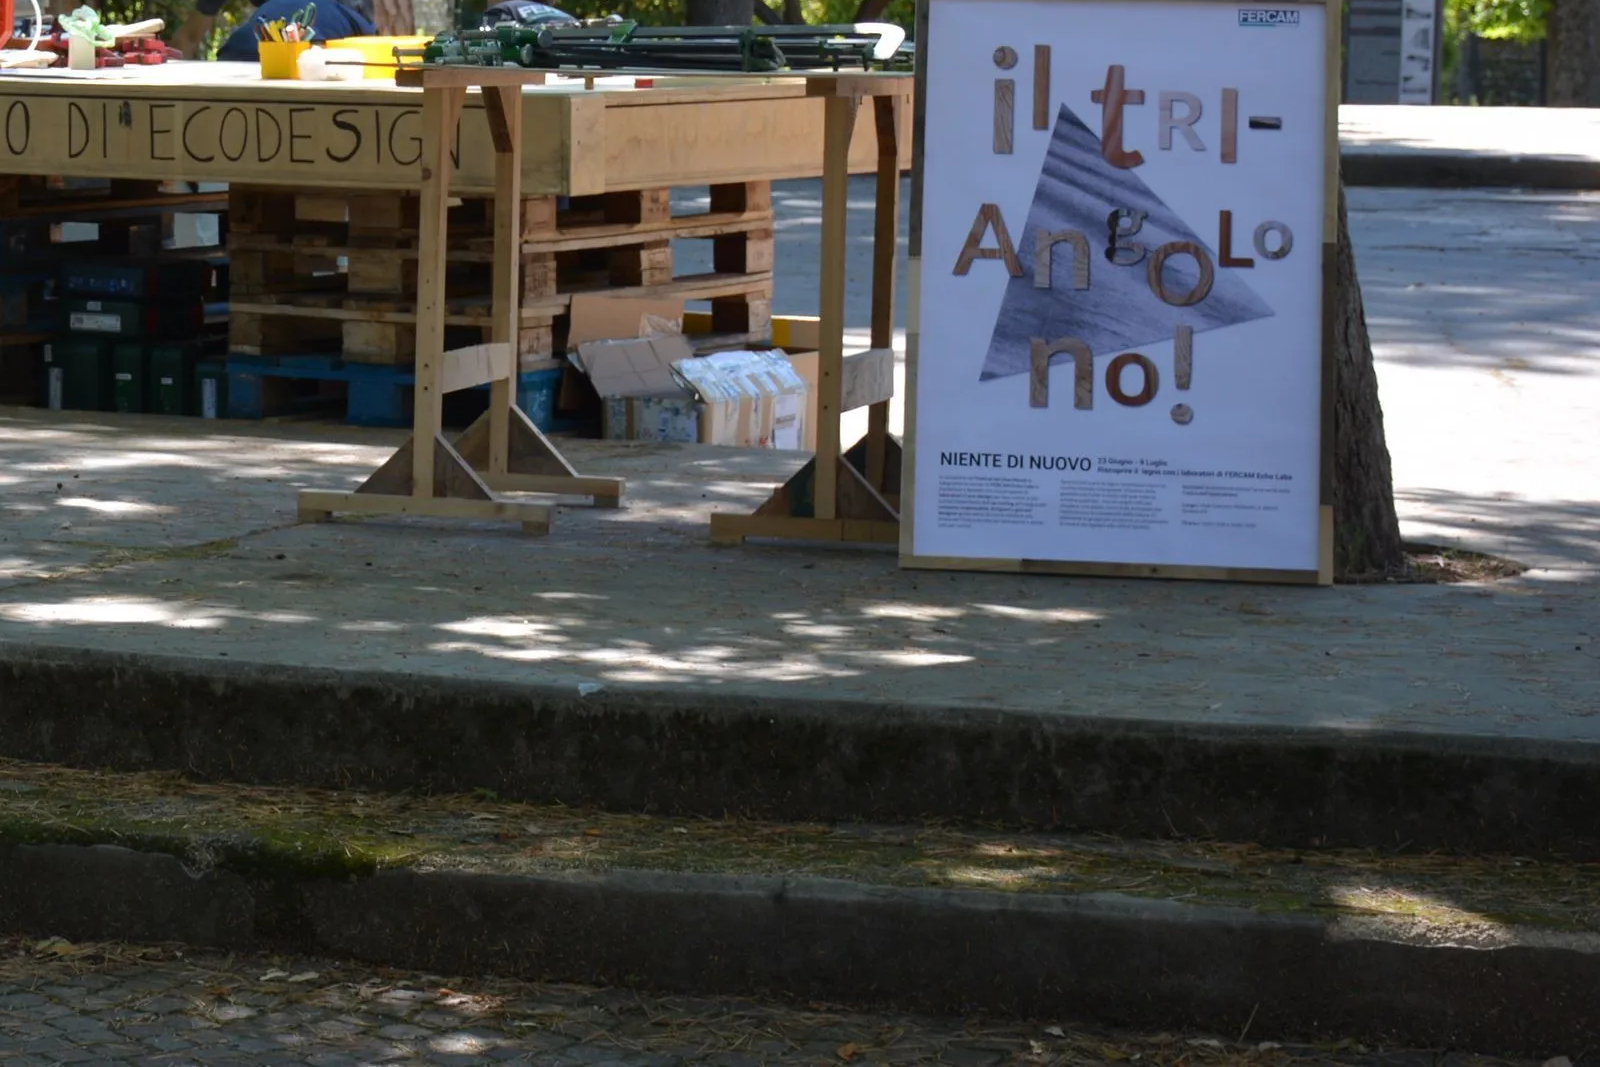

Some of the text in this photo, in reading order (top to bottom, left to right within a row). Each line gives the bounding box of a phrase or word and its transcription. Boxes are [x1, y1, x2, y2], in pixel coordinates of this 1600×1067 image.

[1240, 10, 1298, 23] FERCAM
[993, 44, 1051, 154] il
[68, 101, 107, 159] DI
[1029, 325, 1194, 425] no!
[940, 451, 1092, 471] NIENTE DI NUOVO
